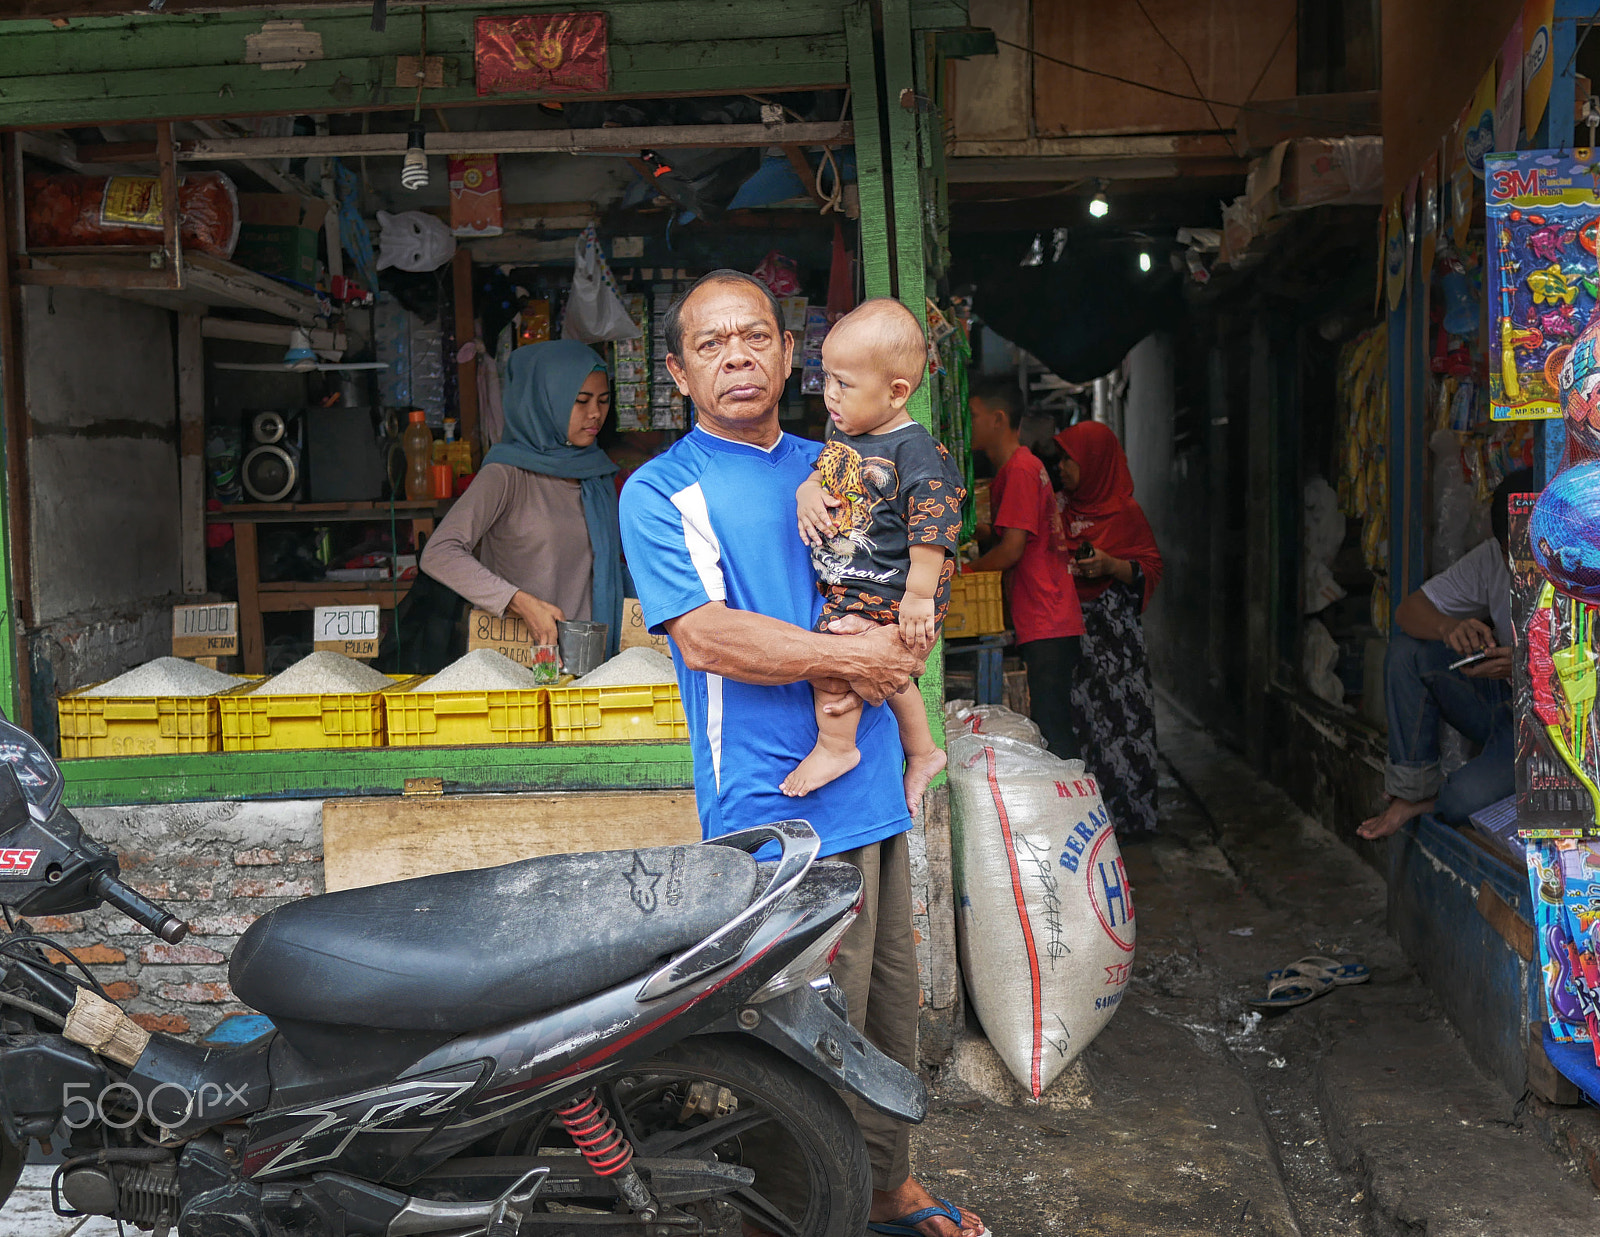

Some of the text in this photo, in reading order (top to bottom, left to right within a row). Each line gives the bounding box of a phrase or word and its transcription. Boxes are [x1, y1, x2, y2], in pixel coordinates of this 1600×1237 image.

[514, 40, 563, 70] 59
[1492, 169, 1539, 199] 3M
[323, 610, 376, 636] 7500
[630, 602, 644, 628] 8
[477, 614, 529, 643] 8000
[208, 636, 235, 650] KETAN
[344, 641, 375, 654] PULEN
[1060, 804, 1108, 875] BERAS
[0, 850, 39, 869] SS
